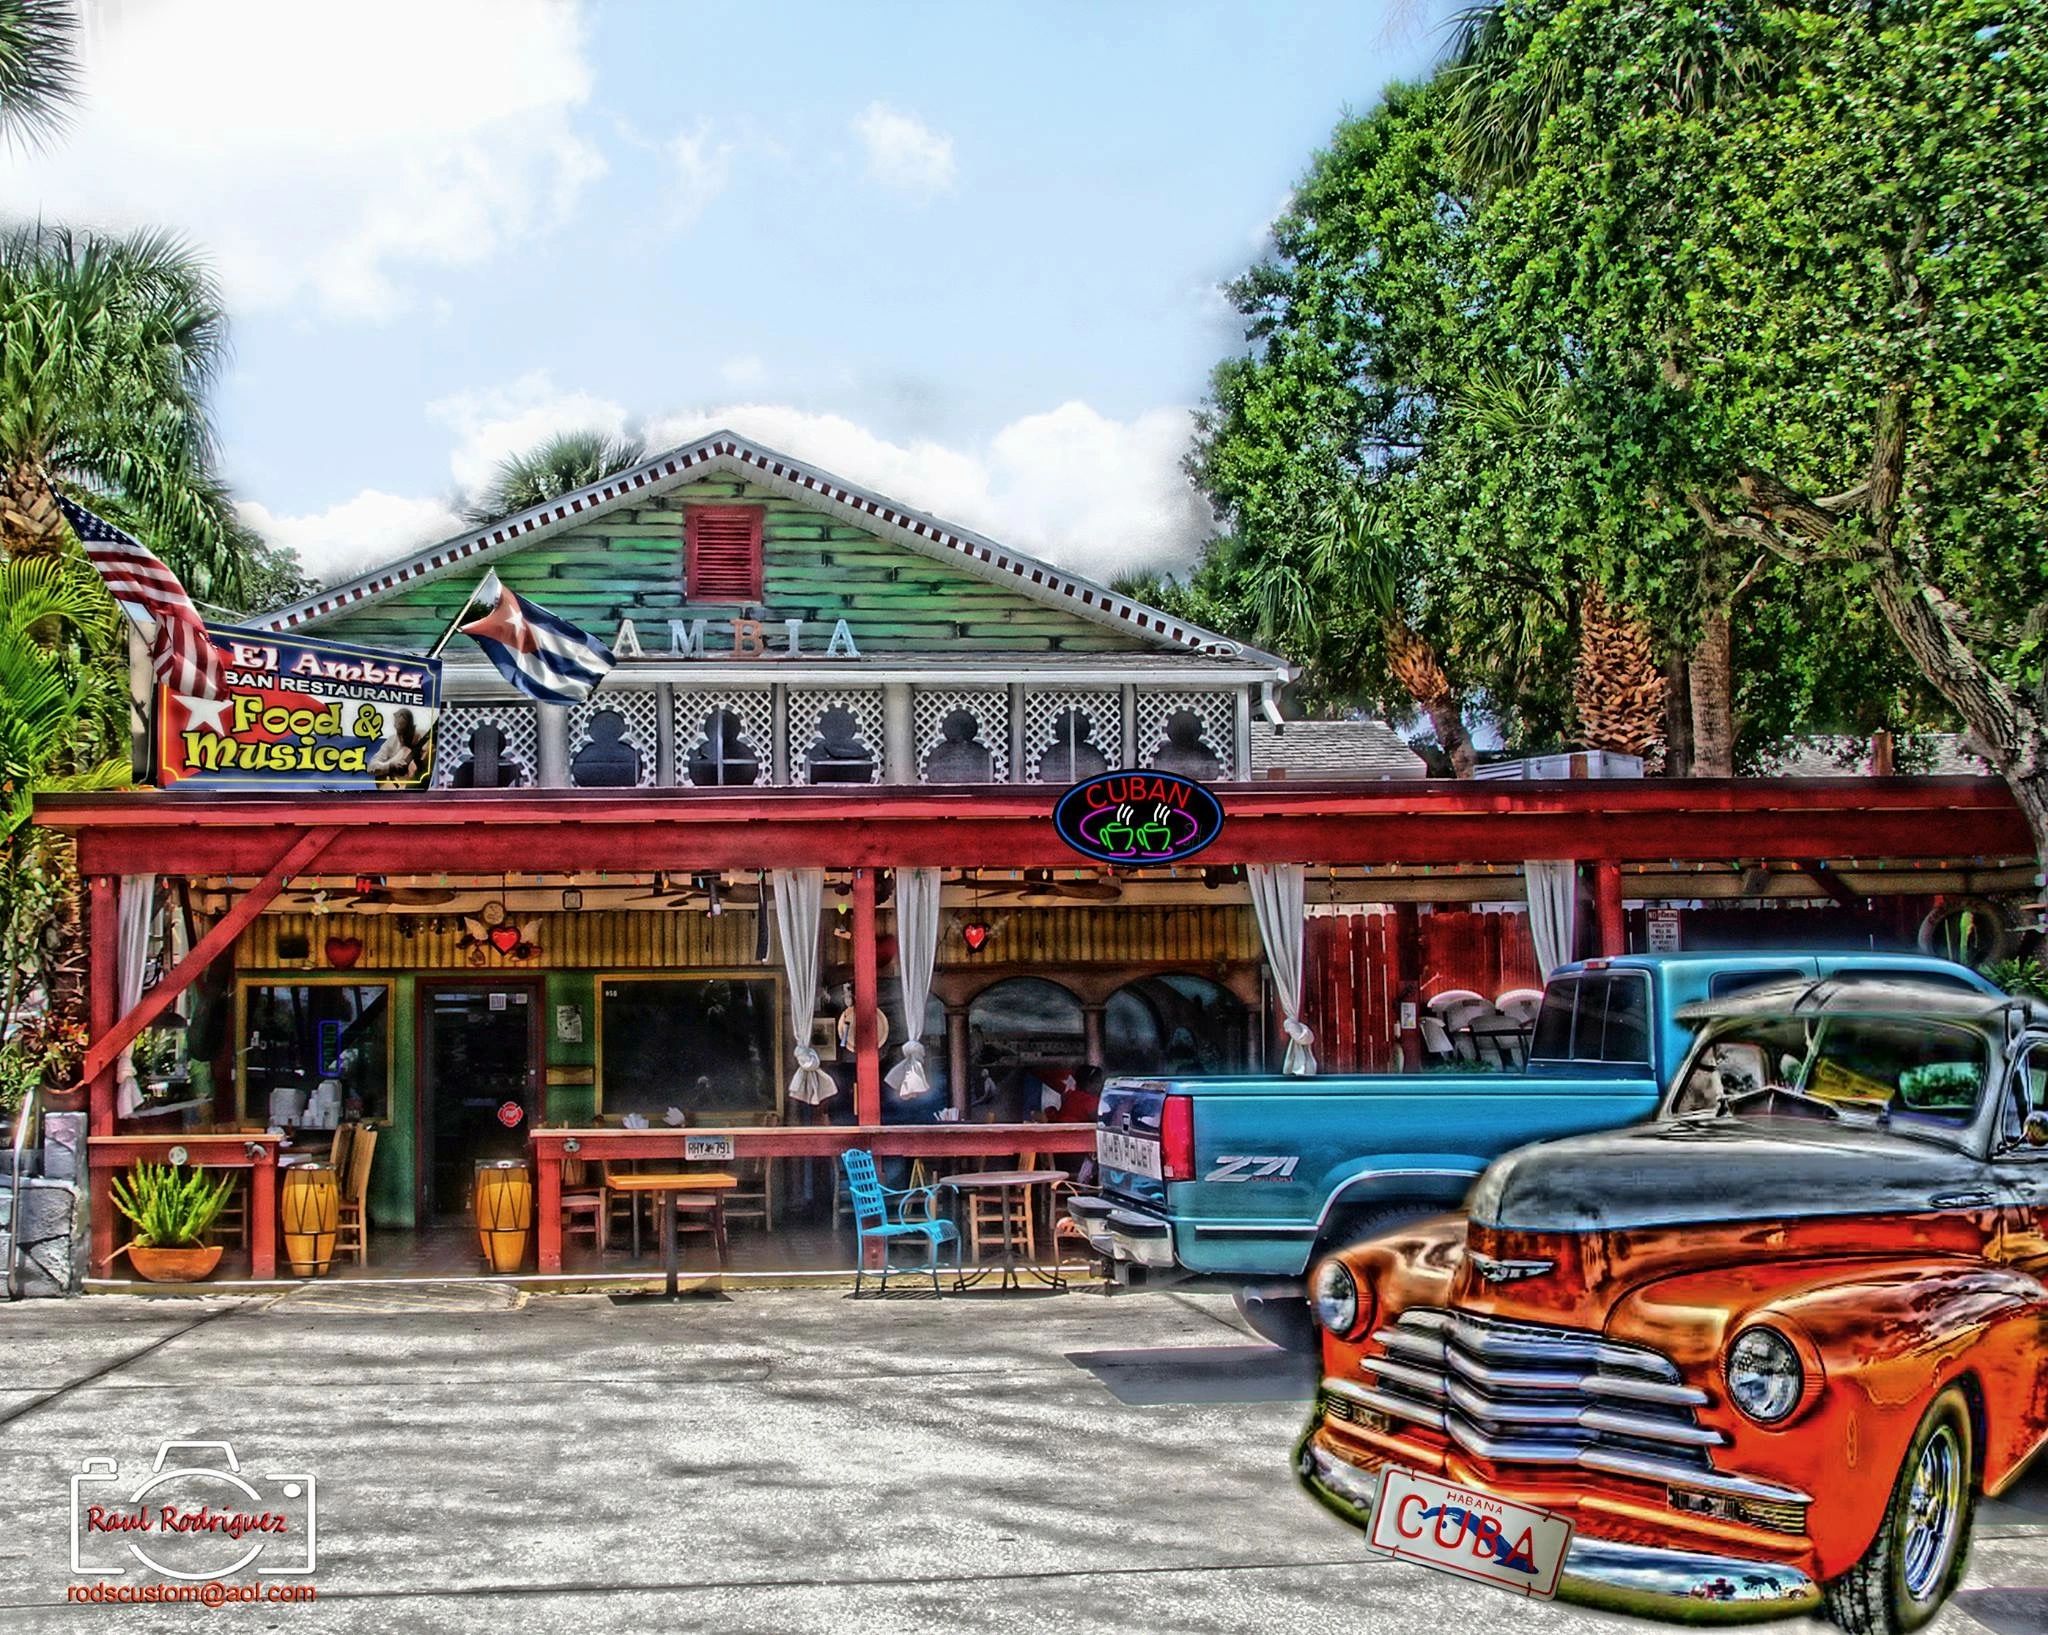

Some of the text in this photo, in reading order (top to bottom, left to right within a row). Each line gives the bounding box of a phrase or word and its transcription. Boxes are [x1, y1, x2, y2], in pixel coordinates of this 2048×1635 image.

[613, 619, 861, 657] AMBIA
[229, 641, 425, 690] El Ambia
[280, 677, 424, 705] RESTAURANTE
[231, 694, 383, 741] Food &
[182, 731, 368, 773] Musica
[1086, 777, 1192, 809] CUBAN
[1204, 1156, 1300, 1182] Z71
[1447, 1491, 1504, 1515] HABANA
[1397, 1494, 1535, 1573] CUBA
